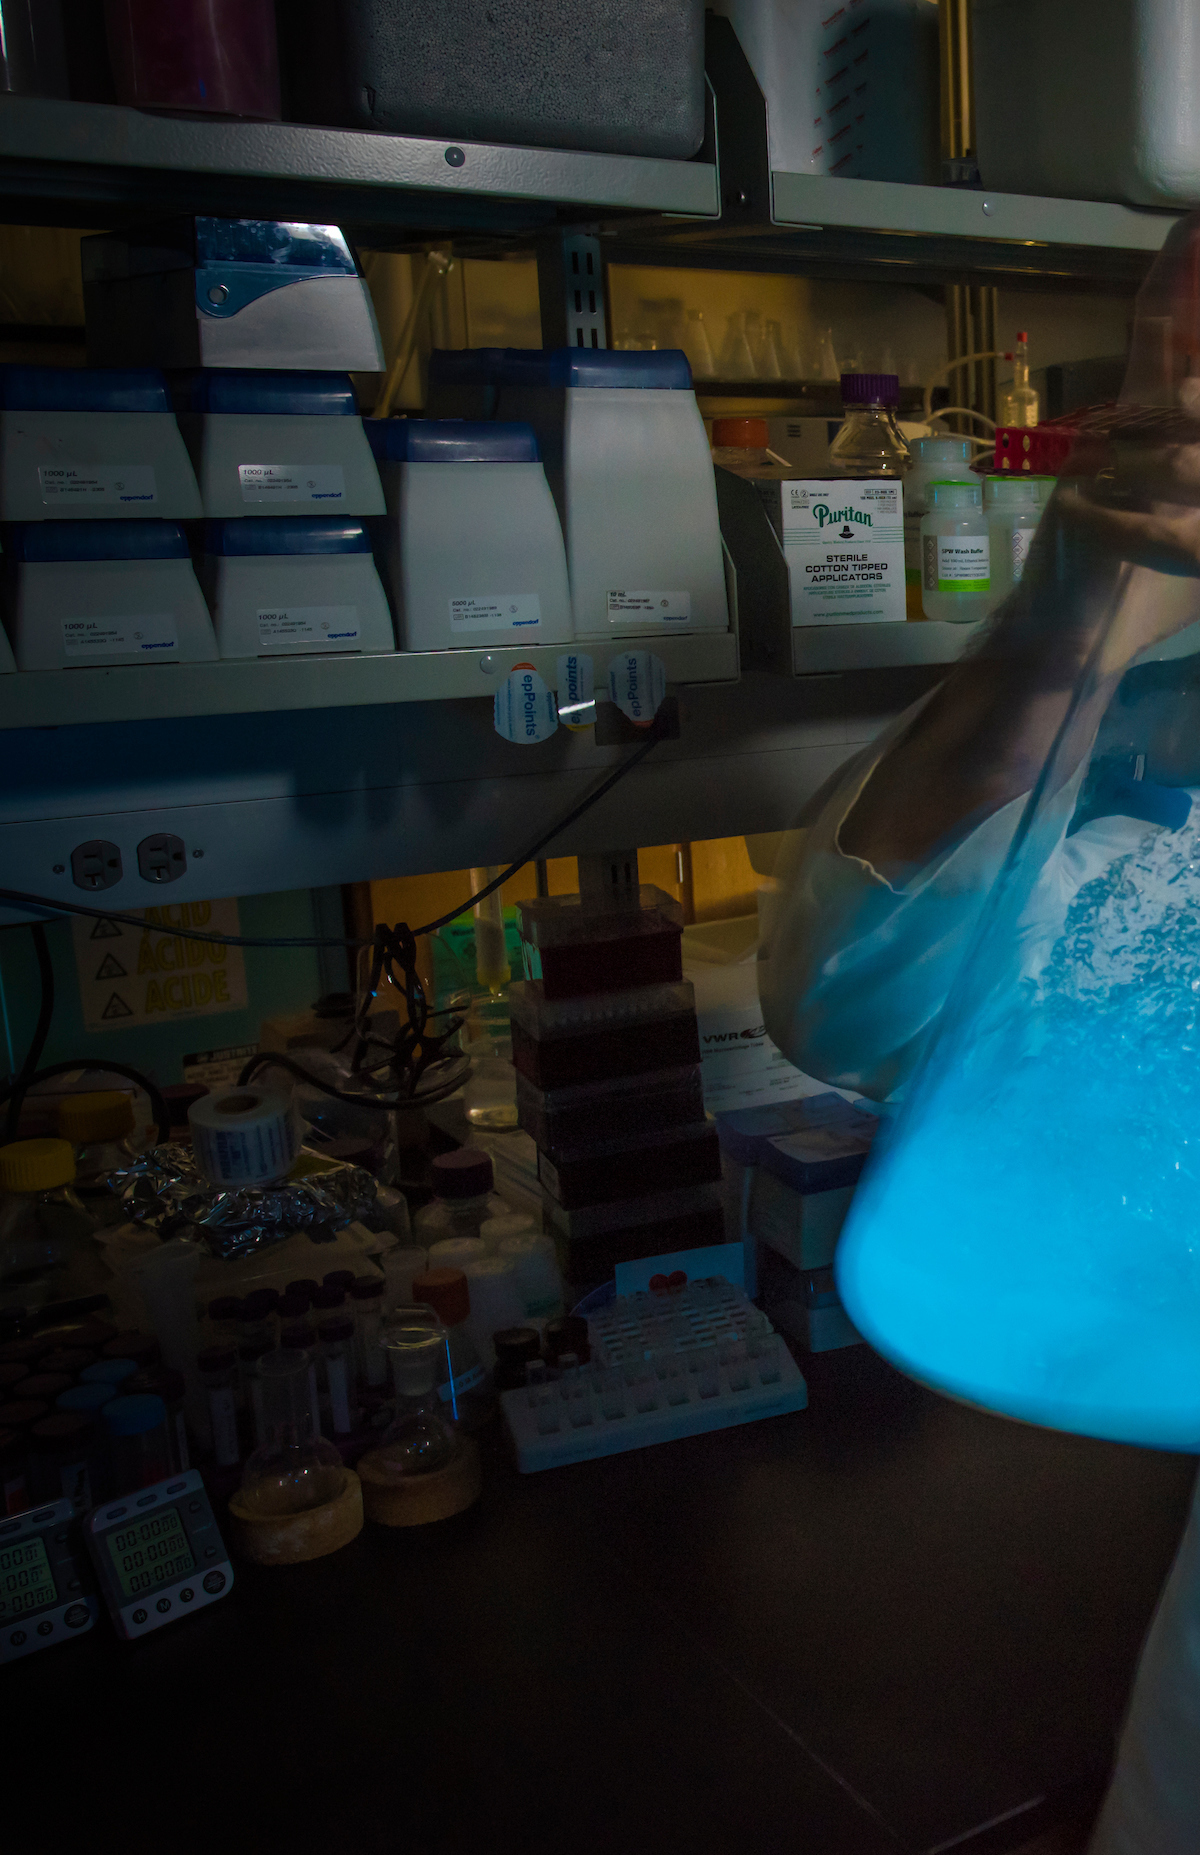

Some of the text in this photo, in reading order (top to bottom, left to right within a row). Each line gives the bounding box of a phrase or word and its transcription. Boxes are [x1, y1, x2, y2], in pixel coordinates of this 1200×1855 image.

[812, 504, 873, 527] Puritan
[826, 554, 868, 562] STERILE
[806, 564, 888, 573] COTTON TIPPED
[812, 573, 882, 582] APPLICATORS
[610, 672, 618, 698] eppendorf
[546, 692, 555, 722] eppendorf
[144, 900, 212, 929] ACID
[145, 970, 230, 1014] ACIDE
[703, 1032, 738, 1043] VWR
[160, 1602, 169, 1610] M
[137, 1612, 144, 1621] H
[43, 1624, 49, 1633] S
[13, 1634, 24, 1644] M
